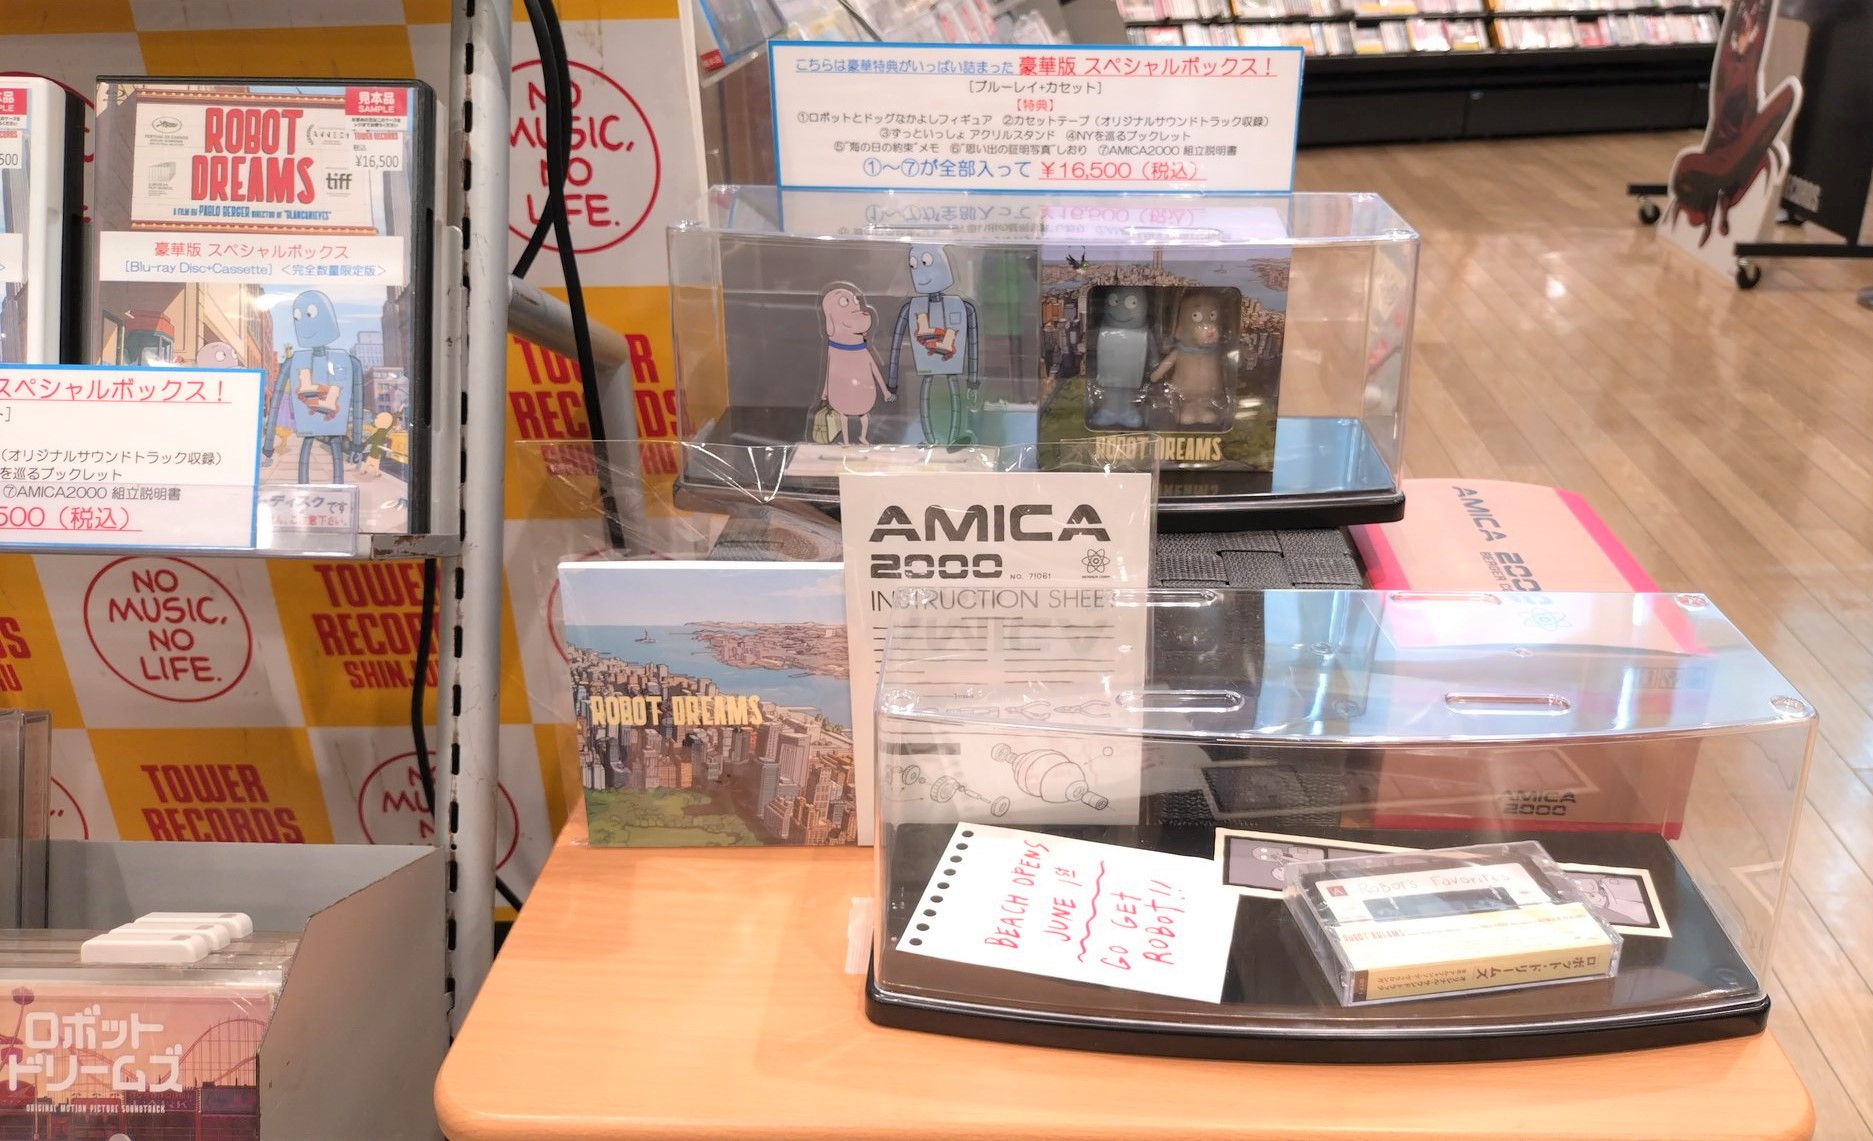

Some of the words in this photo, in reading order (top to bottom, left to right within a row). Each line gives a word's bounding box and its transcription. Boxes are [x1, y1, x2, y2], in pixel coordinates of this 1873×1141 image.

[795, 58, 1014, 74] こちらは豪華特典がいっぱい詰まった
[1018, 56, 1076, 76] 豪華版
[1084, 57, 1272, 76] スペシャルボックス！
[358, 91, 395, 105] 見本品
[358, 105, 395, 113] SAMPLE
[1016, 99, 1054, 112] 【特典】
[797, 112, 993, 125] ①ロボットとドッグなかよしフィギュア
[205, 107, 304, 155] ROBOT
[879, 128, 965, 139] ③ずっといっしょ
[970, 130, 1055, 141] アクリルスタンド
[1066, 131, 1191, 142] ④NYを巡るブックレット
[356, 155, 399, 169] ¥16,500
[1099, 145, 1180, 156] ⑦AMICA2000
[1184, 145, 1237, 156] 組立説明書
[191, 155, 316, 205] DREAMS
[325, 172, 353, 191] tiff
[222, 206, 250, 218] BERGER
[527, 194, 620, 227] LFE.
[154, 241, 202, 258] 豪華版
[208, 243, 349, 260] スペシャルボックス
[1, 449, 223, 466] （オリジナルサウンドトラック収録）
[1095, 436, 1150, 460] ROBOT
[1155, 437, 1222, 461] DREAMS
[0, 467, 122, 482] を巡るブックレット
[3, 484, 108, 500] ⑦AMICA2000
[111, 486, 181, 501] 組立説明書
[869, 504, 1111, 542] AMICA
[1452, 486, 1507, 541] AMICA
[870, 553, 1003, 579] 2000
[131, 569, 178, 593] NO
[108, 597, 228, 625] MUSIC,
[871, 589, 1038, 611] INSTRUCTION
[149, 629, 195, 652] NO
[139, 655, 223, 683] LIFE.
[590, 695, 662, 726] ROBOT
[672, 694, 763, 726] DREAMS
[140, 764, 267, 803] TOWER
[1503, 803, 1567, 816] 2000
[141, 807, 304, 842] RECORDS
[985, 894, 1029, 949] BEACH
[1013, 839, 1050, 887] OPENS
[1043, 897, 1077, 942] JUNE
[1111, 891, 1142, 929] GET
[1100, 945, 1131, 971] GO
[25, 1004, 164, 1049] ロボット
[8, 1043, 183, 1092] ドリームズ
[60, 1104, 87, 1113] MOTION
[90, 1105, 118, 1113] PICTURE
[121, 1105, 166, 1114] SOUNDTRACK
